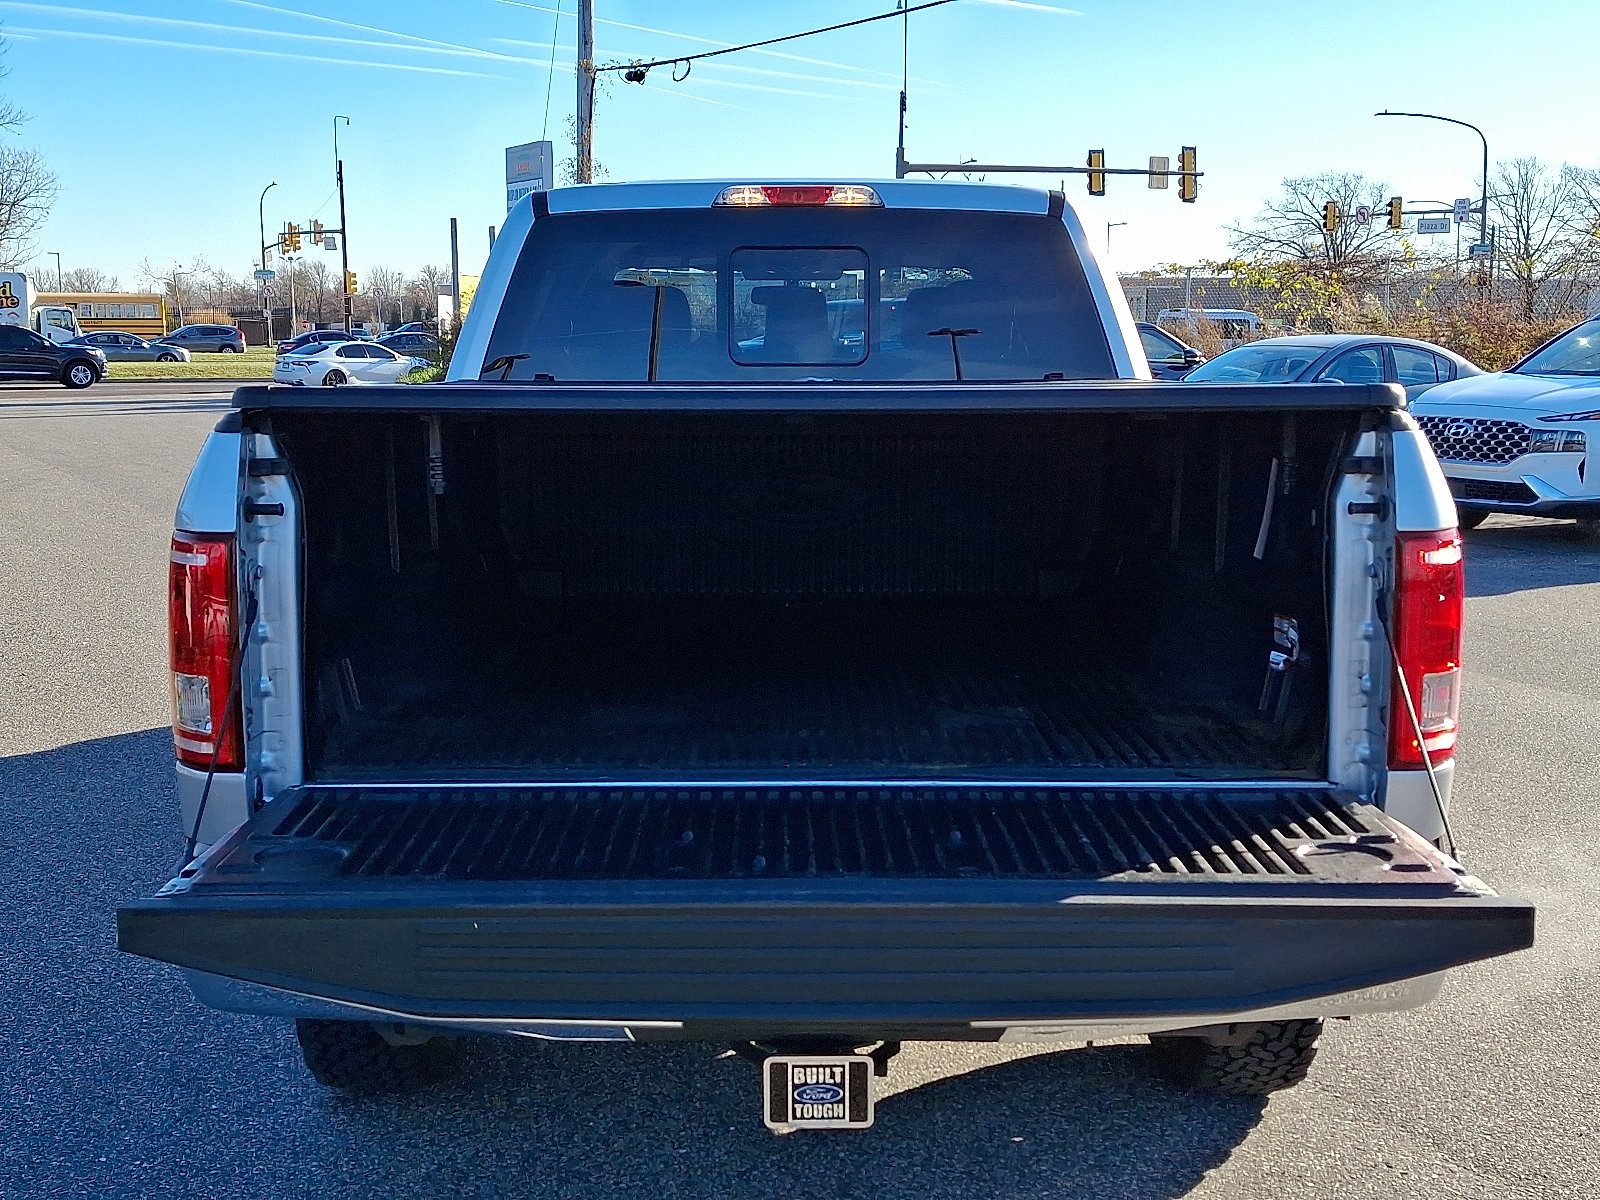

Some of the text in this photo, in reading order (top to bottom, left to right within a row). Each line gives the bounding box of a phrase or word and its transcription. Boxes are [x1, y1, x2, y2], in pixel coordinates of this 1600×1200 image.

[1420, 222, 1448, 231] Plaza Dr
[793, 1067, 844, 1084] BUILT
[803, 1089, 833, 1099] Ford
[793, 1103, 844, 1119] TOUGH
